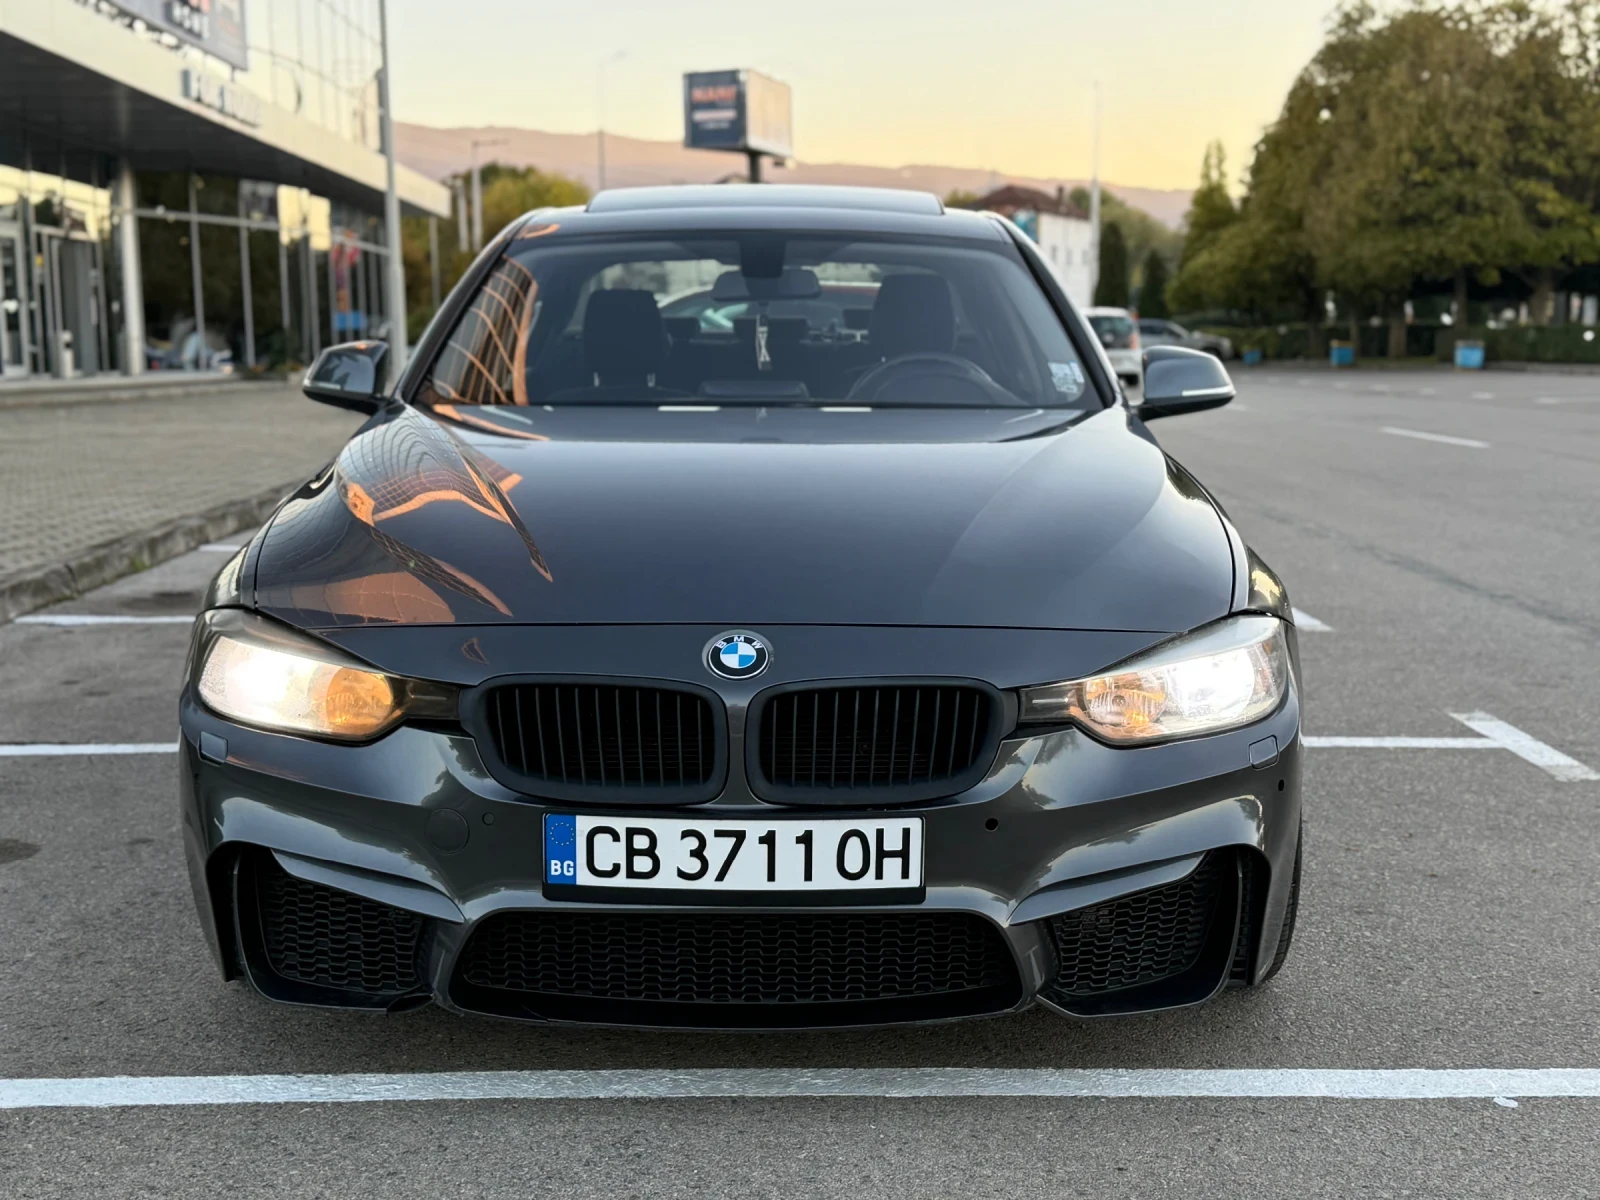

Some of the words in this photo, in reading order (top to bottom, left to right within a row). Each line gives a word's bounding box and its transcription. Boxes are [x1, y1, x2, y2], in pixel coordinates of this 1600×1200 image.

[715, 635, 764, 649] BMW
[586, 826, 661, 879] CB
[677, 829, 813, 882] 3711
[836, 827, 911, 881] OH
[550, 859, 574, 876] BG
